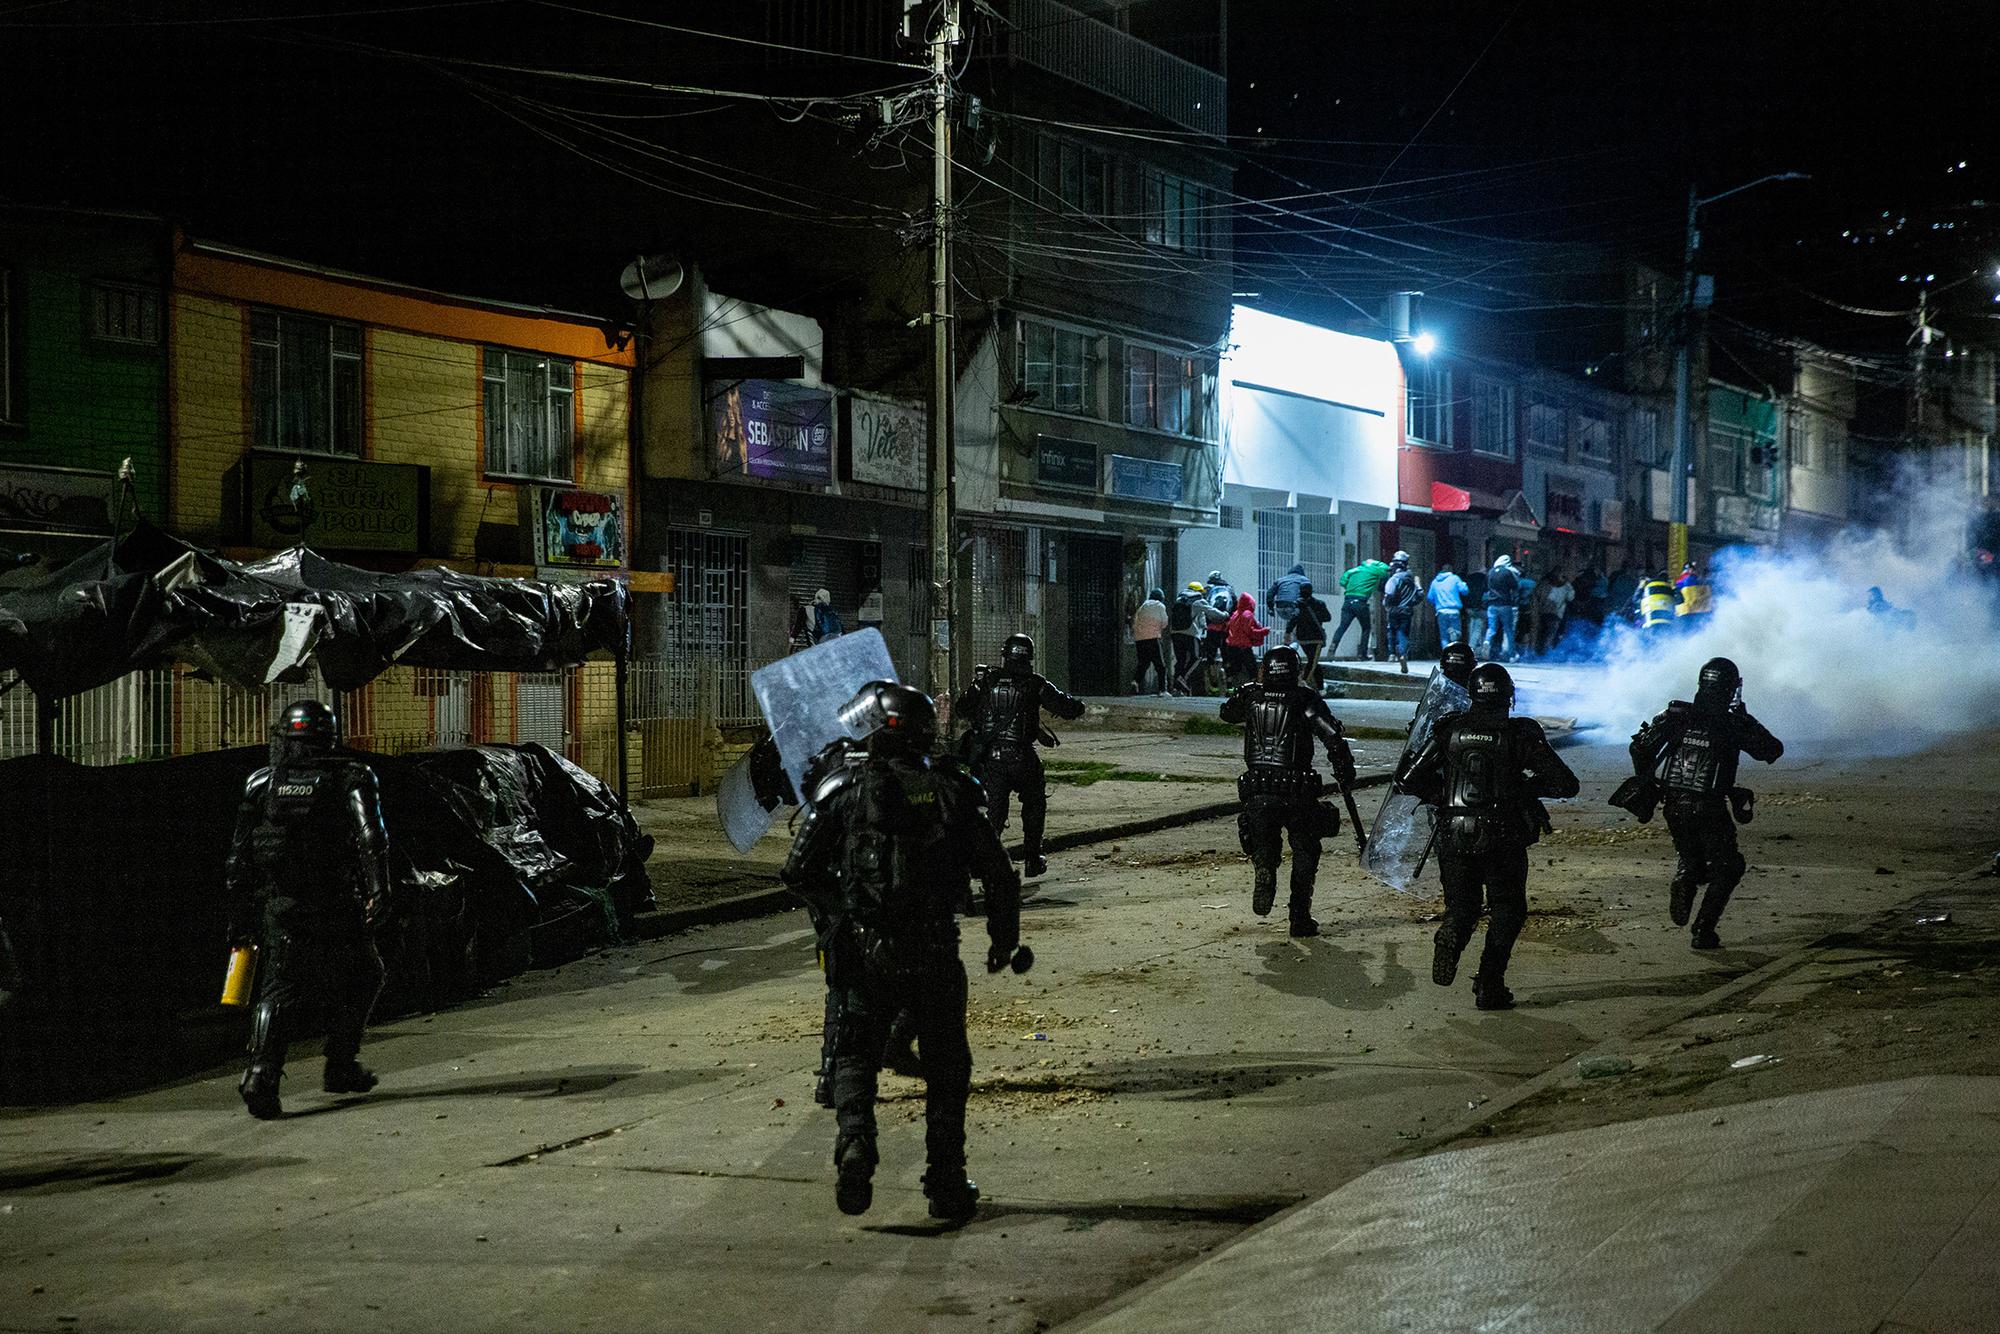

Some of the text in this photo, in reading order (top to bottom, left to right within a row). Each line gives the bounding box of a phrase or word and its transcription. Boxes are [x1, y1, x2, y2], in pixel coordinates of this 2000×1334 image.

[747, 420, 809, 452] SEBASTIAN
[327, 466, 377, 488] EL
[319, 488, 401, 511] BUEN
[322, 511, 413, 535] POLLO
[278, 785, 313, 797] 115200
